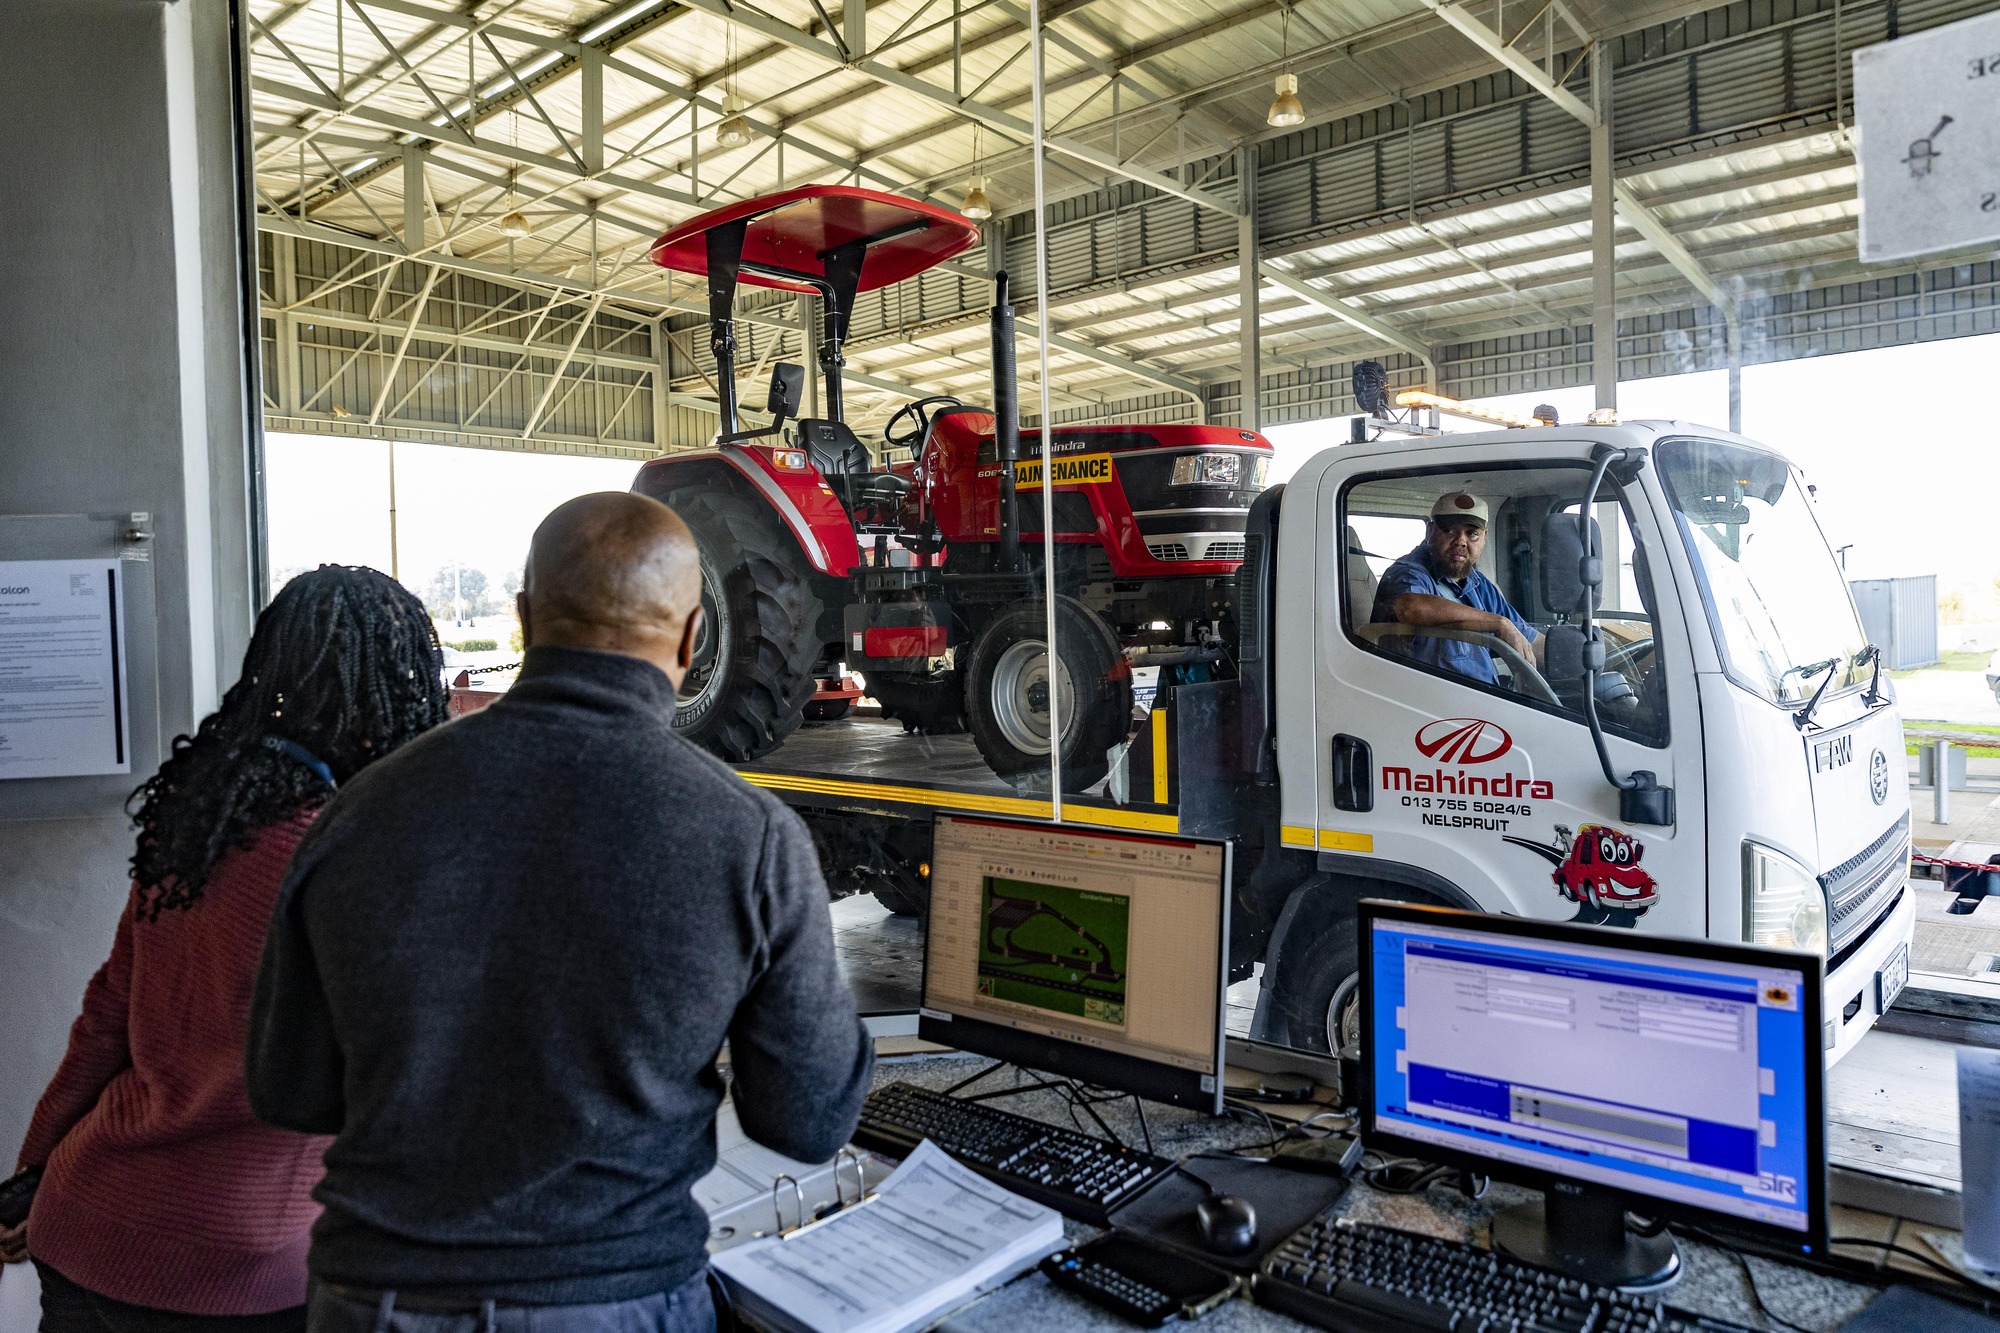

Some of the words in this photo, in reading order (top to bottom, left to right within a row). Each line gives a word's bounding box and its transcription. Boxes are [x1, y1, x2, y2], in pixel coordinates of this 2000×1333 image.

[1014, 458, 1109, 484] AINENANCE
[1814, 734, 1853, 773] FAW
[1382, 766, 1554, 800] Mahindra
[1401, 796, 1431, 809] 013
[1436, 798, 1467, 811] 755
[1473, 801, 1531, 817] 5024/6
[1422, 813, 1509, 832] NELSPRUIT
